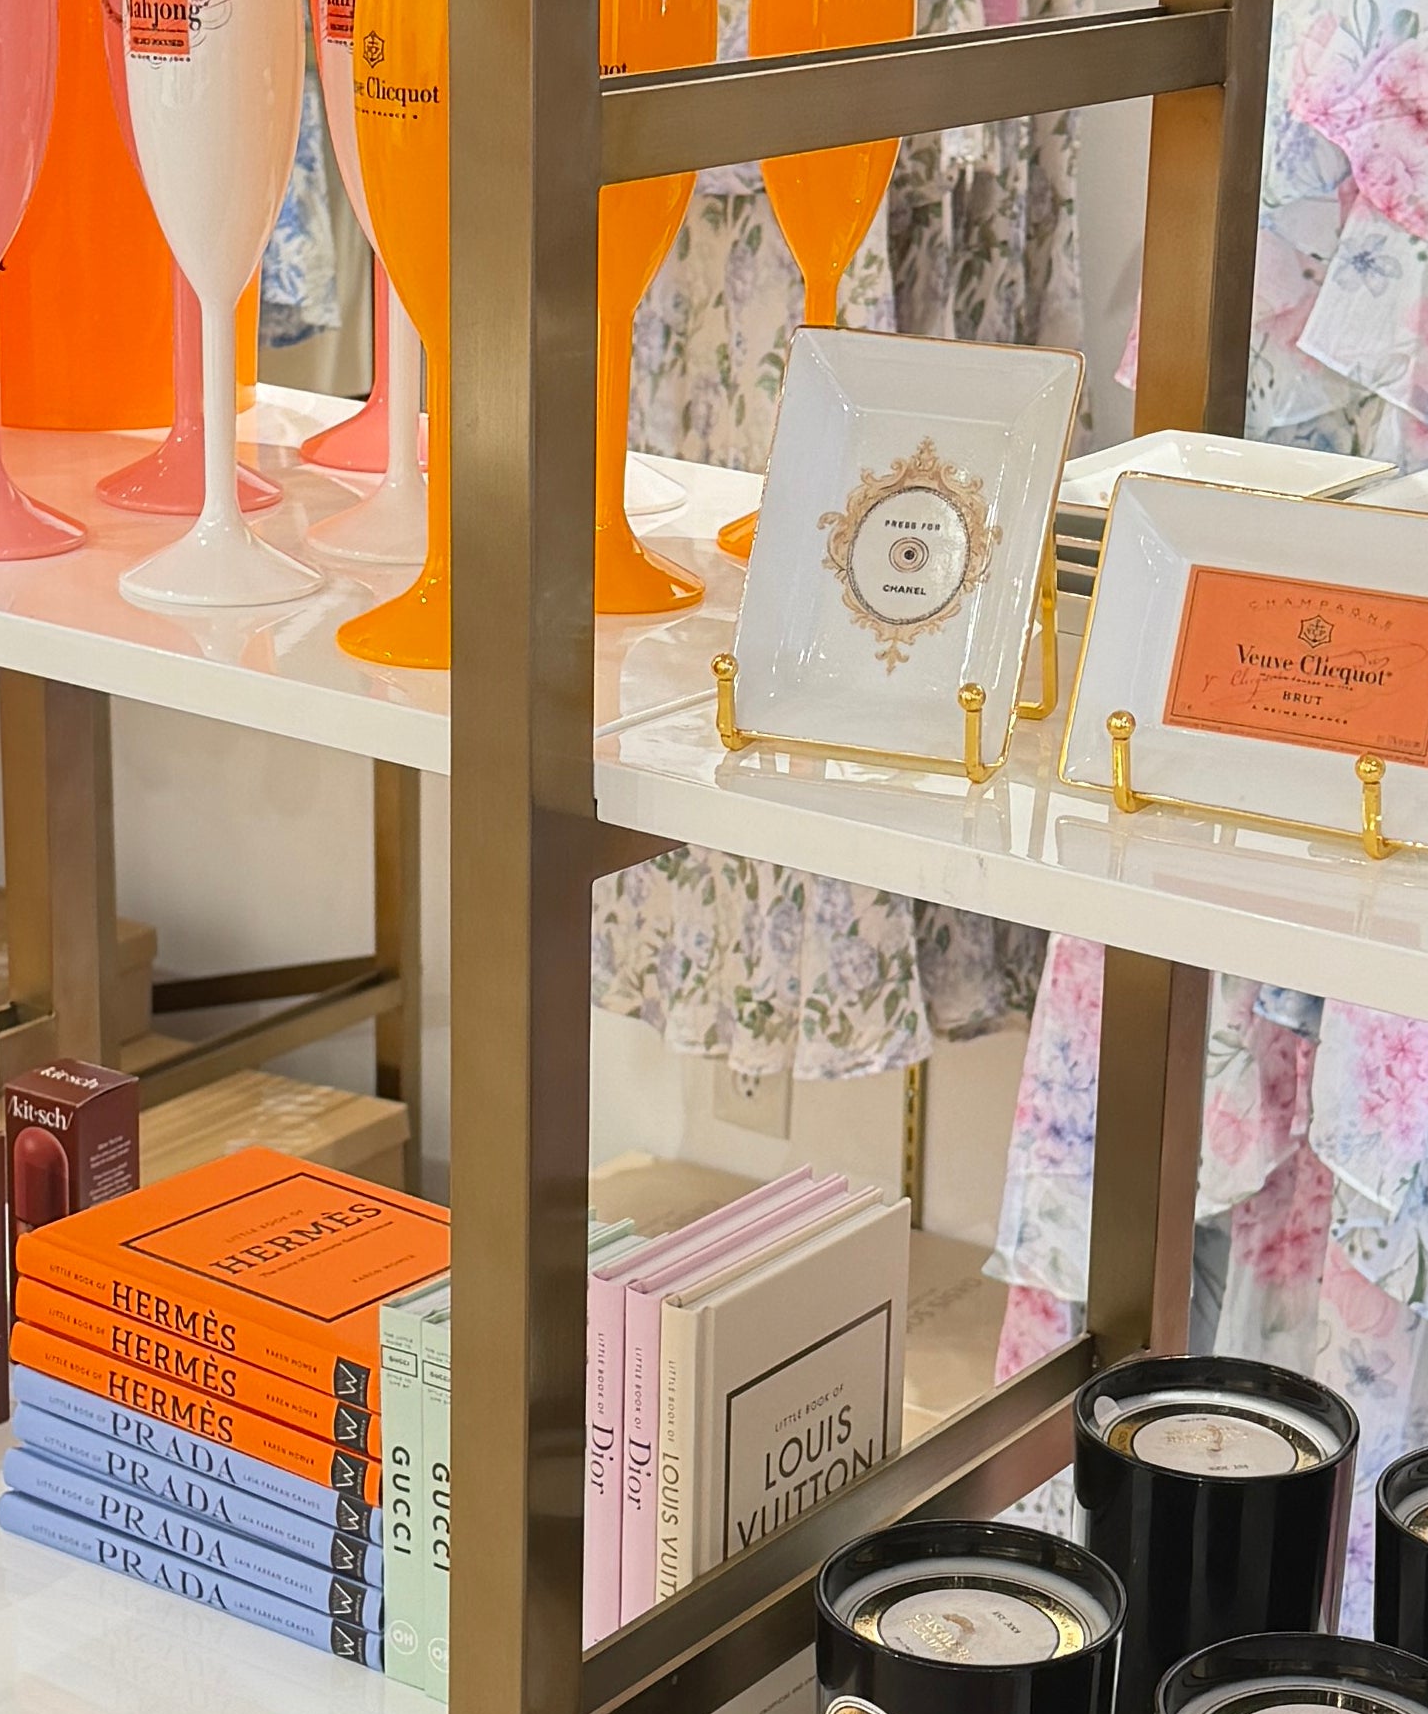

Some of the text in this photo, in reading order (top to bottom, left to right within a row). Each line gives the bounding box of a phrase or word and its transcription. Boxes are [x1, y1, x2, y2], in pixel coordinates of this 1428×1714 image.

[365, 75, 441, 107] Clicquot
[883, 518, 941, 532] PRESS FOR
[882, 583, 927, 597] CHANEL
[1248, 597, 1395, 633] CHAMPAGNE
[1235, 643, 1295, 674] Veuve
[1299, 653, 1389, 688] Clicquot
[1281, 689, 1325, 707] BRUT
[208, 1202, 383, 1276] HERMÈS
[48, 1307, 71, 1324] LITTLE
[72, 1317, 94, 1331] BOOK
[95, 1326, 106, 1336] OF
[111, 1324, 237, 1398] HERMÈS
[49, 1263, 72, 1280] LITTLE
[73, 1273, 94, 1287] BOOK
[96, 1281, 107, 1291] OF
[111, 1279, 237, 1353] HERMÈS
[44, 1352, 68, 1369] LITTLE
[69, 1362, 90, 1378] BOOK
[92, 1371, 103, 1381] OF
[107, 1370, 234, 1444] HERMÈS
[48, 1395, 72, 1411] LITTLE
[72, 1405, 95, 1420] BOOK
[95, 1413, 106, 1424] OF
[109, 1409, 238, 1485] PRADA
[590, 1331, 615, 1495] LITTLE BOOK OF Dior
[627, 1346, 652, 1511] LITTLE BOOK OF Dior
[774, 1383, 845, 1433] LITTLE BOOK OF
[43, 1435, 67, 1452] LITTLE
[68, 1445, 91, 1460] BOOK
[91, 1452, 102, 1463] OF
[106, 1449, 233, 1524] PRADA
[661, 1359, 680, 1527] LITTLE BOOK OF LOUIS
[764, 1403, 852, 1491] LOUIS
[36, 1477, 60, 1494] LITTLE
[61, 1487, 83, 1503] BOOK
[84, 1496, 96, 1507] OF
[99, 1492, 229, 1569] PRADA
[391, 1445, 412, 1555] GUCCI
[431, 1461, 451, 1572] GUCCI
[737, 1438, 874, 1549] VUITTON
[31, 1523, 56, 1540] LITTLE
[58, 1533, 80, 1547] BOOK
[80, 1540, 93, 1551] OF
[95, 1537, 229, 1612] PRADA
